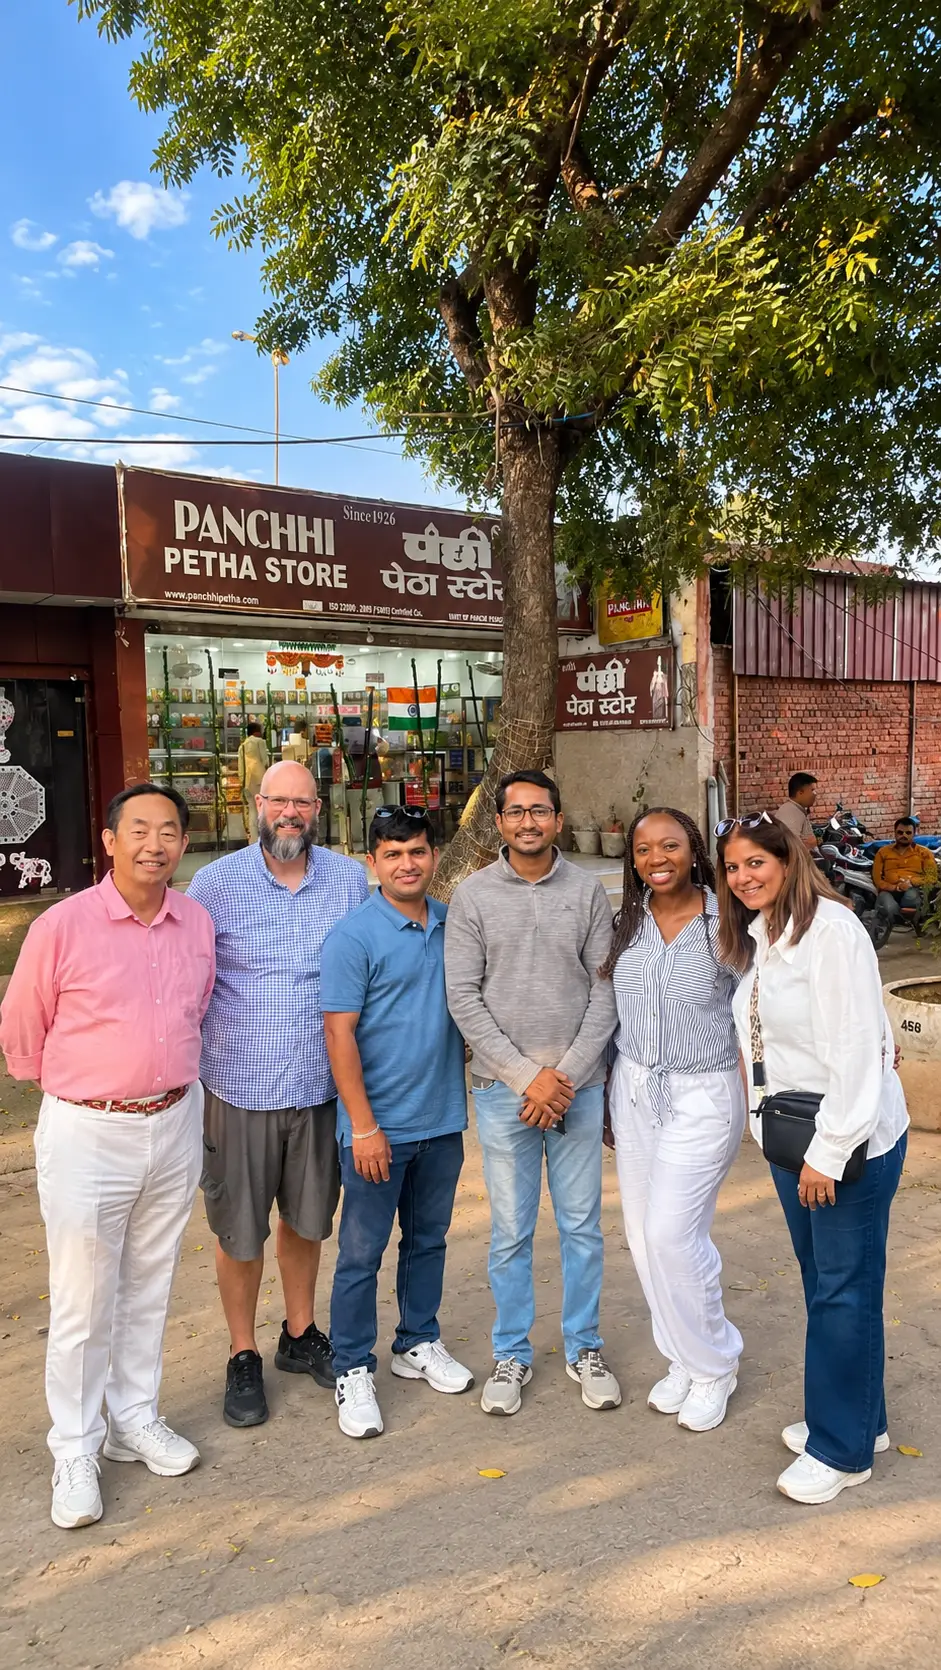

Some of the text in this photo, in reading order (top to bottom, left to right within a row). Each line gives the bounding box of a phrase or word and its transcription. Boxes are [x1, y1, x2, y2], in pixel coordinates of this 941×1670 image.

[174, 499, 335, 556] PANCHHI
[343, 504, 396, 526] Since 1926
[164, 547, 348, 589] PETHA STORE
[379, 561, 439, 596] पेठा
[164, 590, 259, 605] www.panchhipetha.com
[565, 690, 637, 716] पेठा स्टोर
